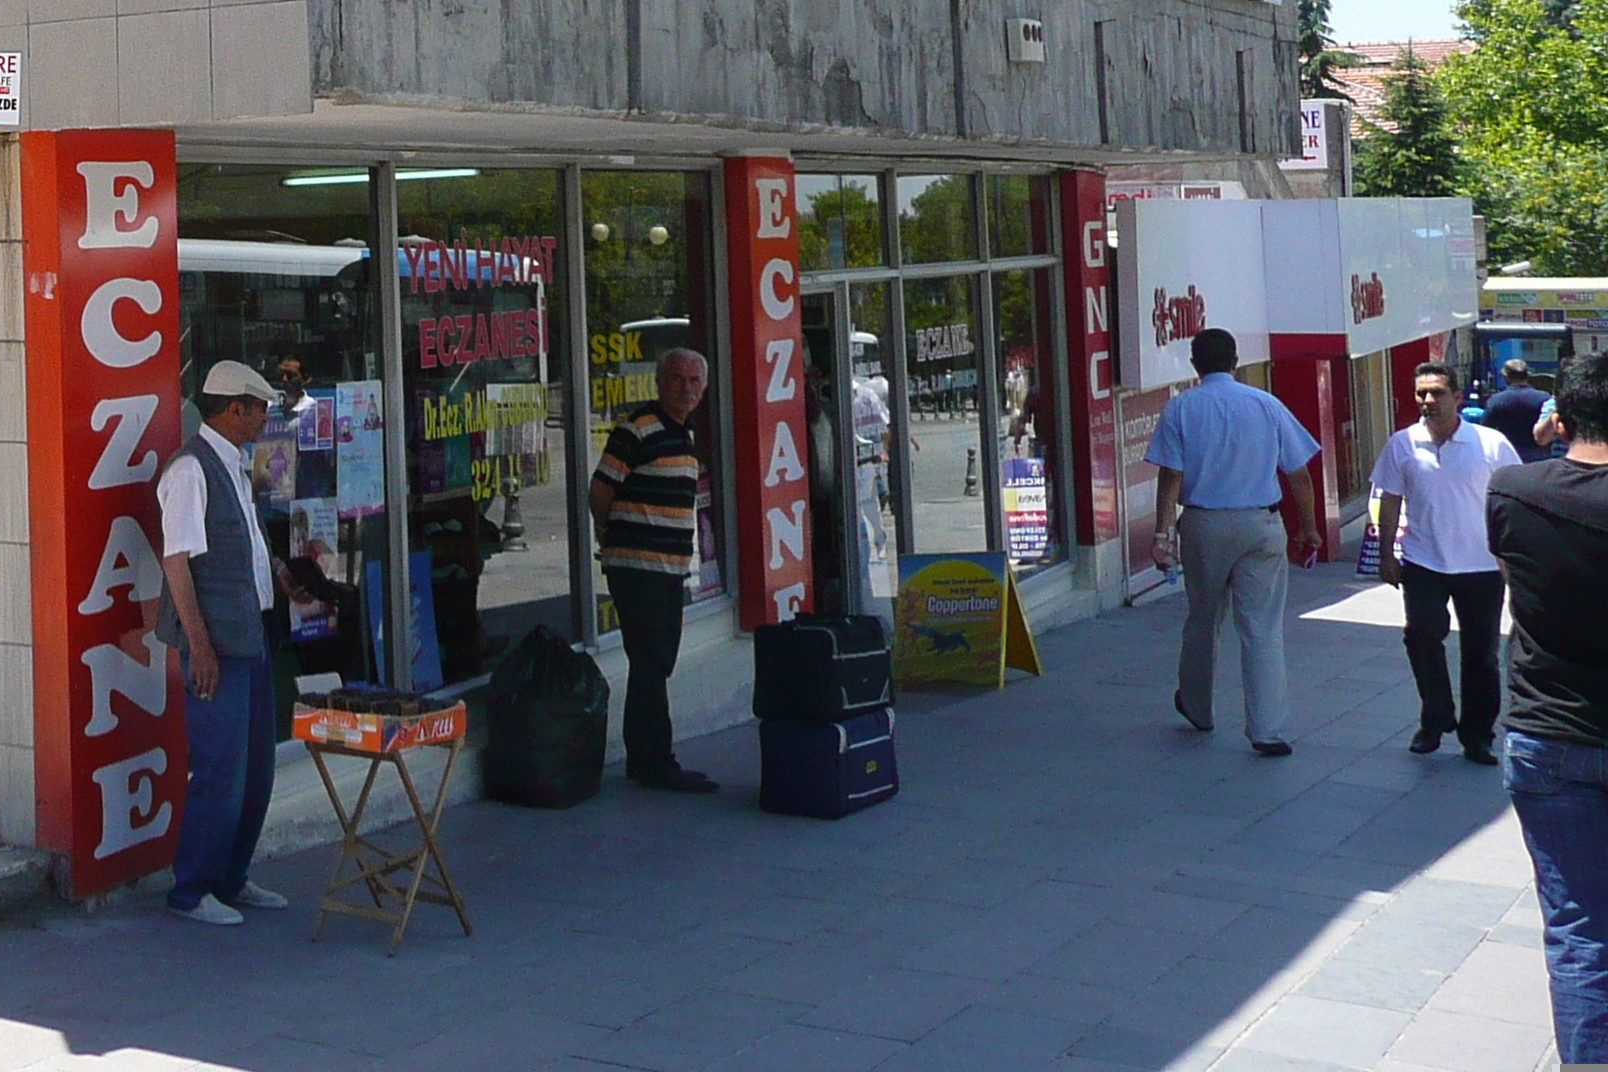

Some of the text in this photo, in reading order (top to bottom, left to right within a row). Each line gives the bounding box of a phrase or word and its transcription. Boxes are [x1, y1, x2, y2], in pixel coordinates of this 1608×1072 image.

[403, 228, 557, 294] YENİ HAYAT
[419, 297, 549, 369] ECZANESİ
[1083, 221, 1110, 400] GNC
[1168, 284, 1206, 342] smile
[592, 330, 643, 365] SSK
[471, 454, 502, 503] 324
[77, 160, 172, 860] ECZANE
[926, 596, 998, 615] Coppertone
